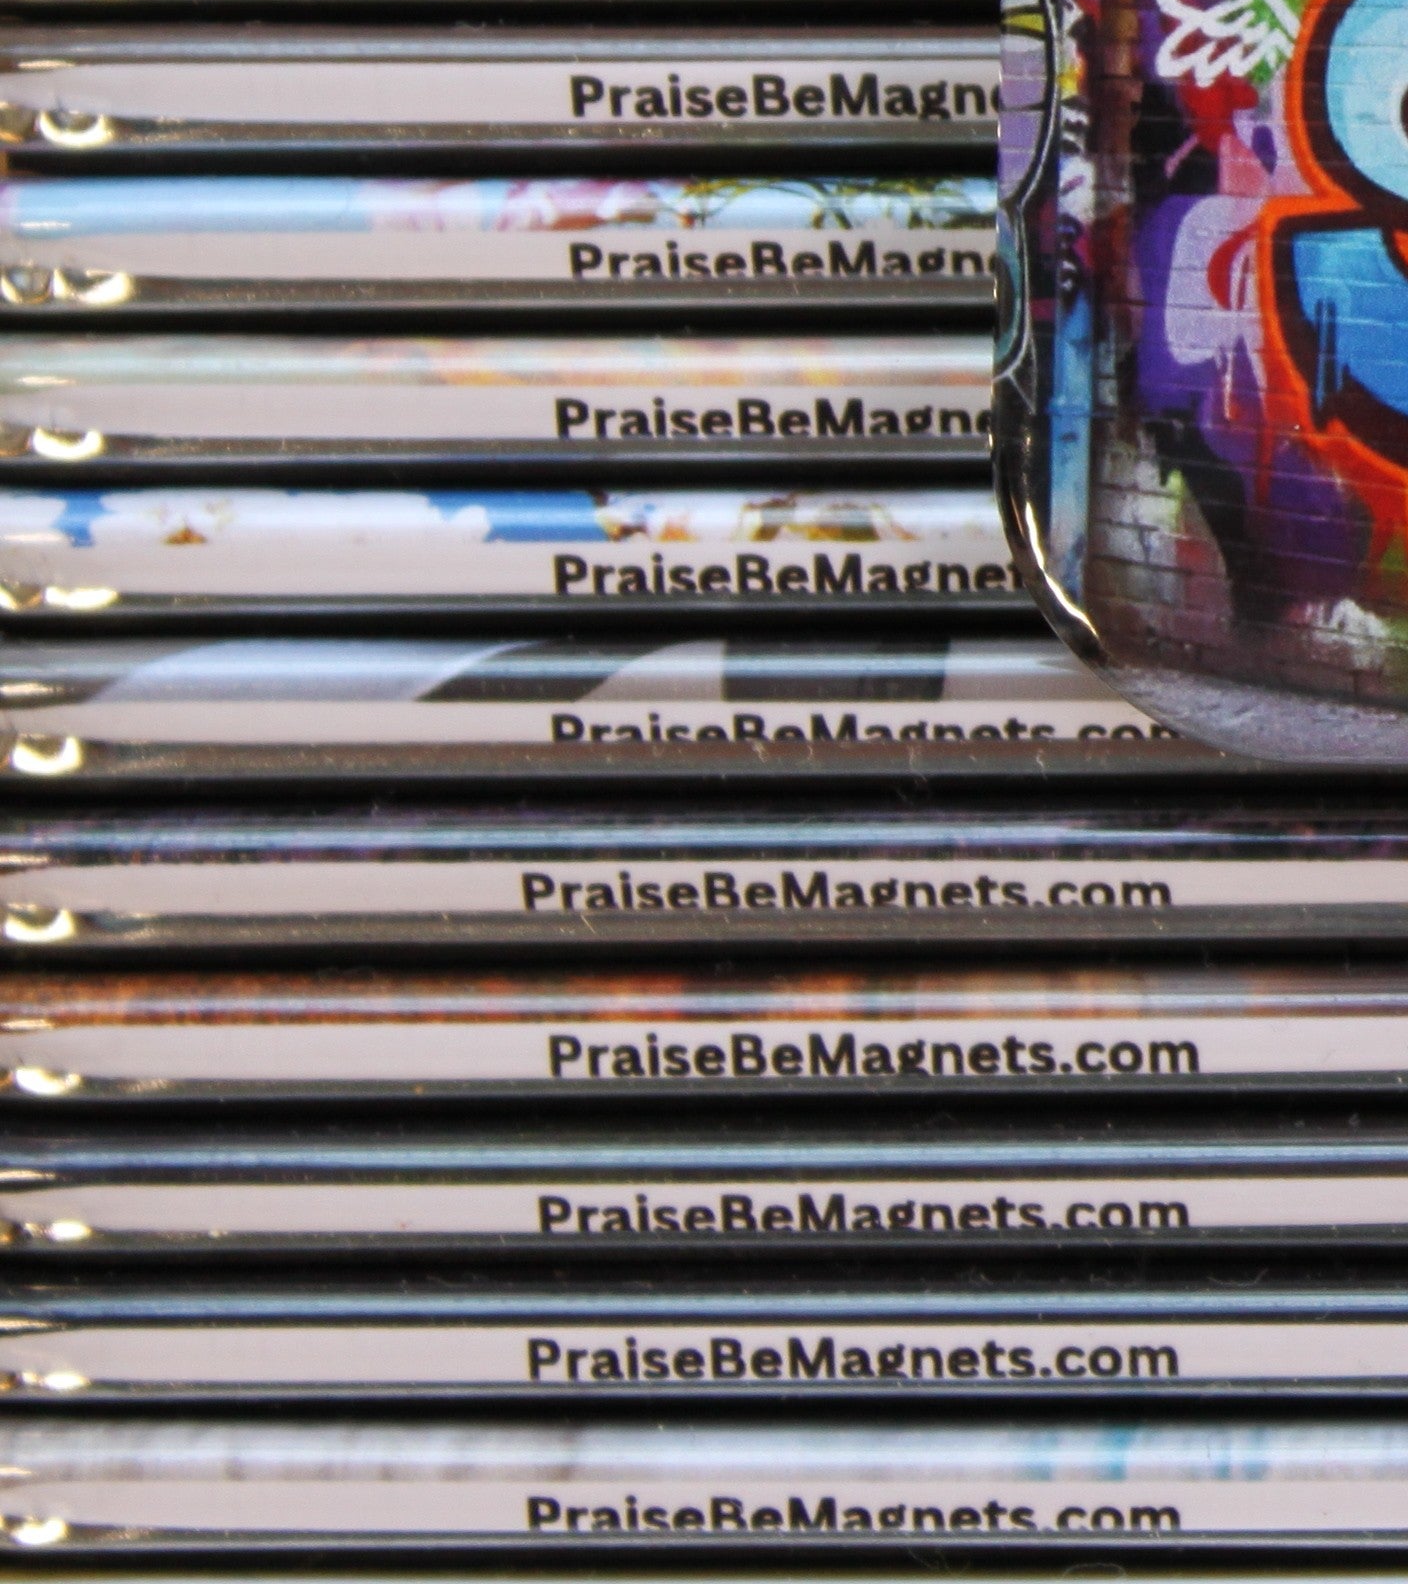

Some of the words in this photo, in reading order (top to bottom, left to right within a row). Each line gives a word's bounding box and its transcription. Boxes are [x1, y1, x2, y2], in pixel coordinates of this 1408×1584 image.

[521, 871, 1173, 911] PraiseBeMagnets.com
[548, 1032, 1199, 1080] PraiseBeMagnets.com
[538, 1194, 1190, 1236] PraiseBeMagnets.com
[527, 1336, 1180, 1382] PraiseBeMagnets.com
